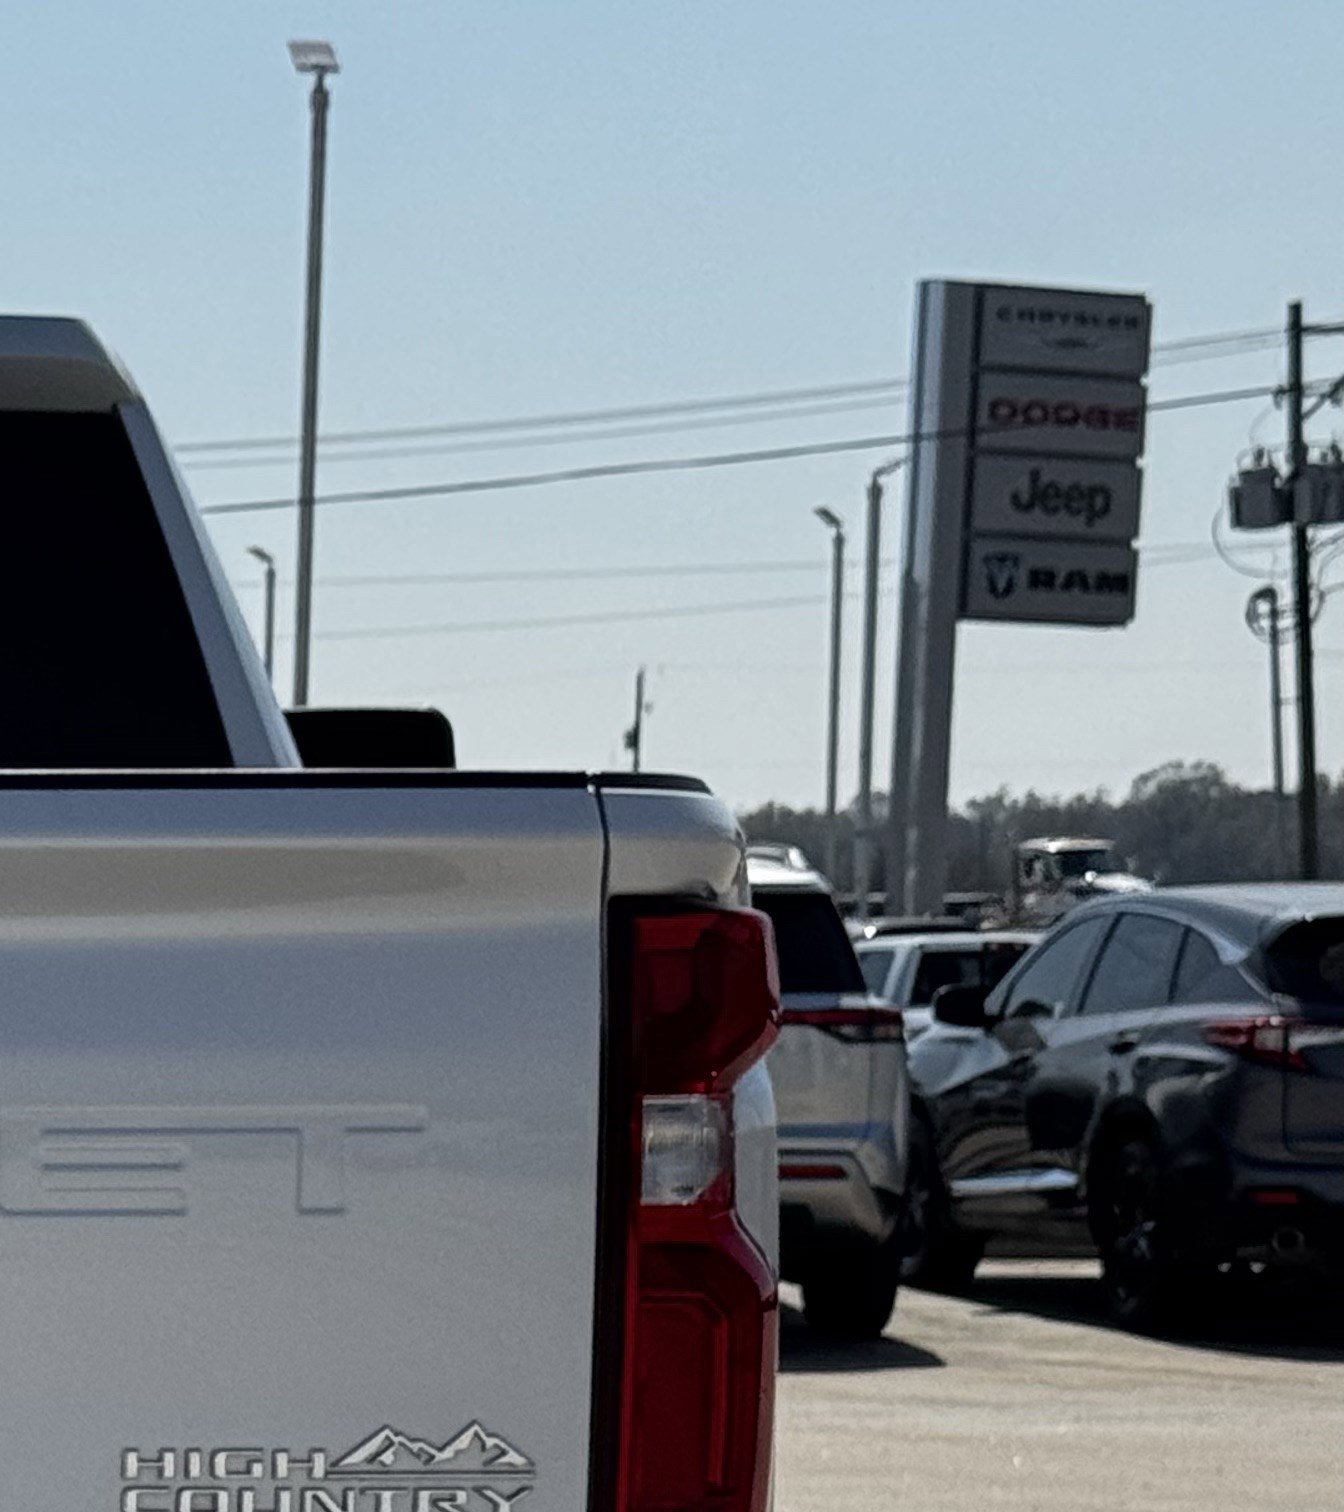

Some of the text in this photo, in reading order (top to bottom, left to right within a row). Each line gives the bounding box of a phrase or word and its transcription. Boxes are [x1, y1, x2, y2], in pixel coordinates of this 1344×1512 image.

[989, 399, 1139, 431] DODGE
[1012, 468, 1111, 527] Jeep
[1028, 568, 1129, 593] RAM
[121, 1448, 327, 1479] HIGH
